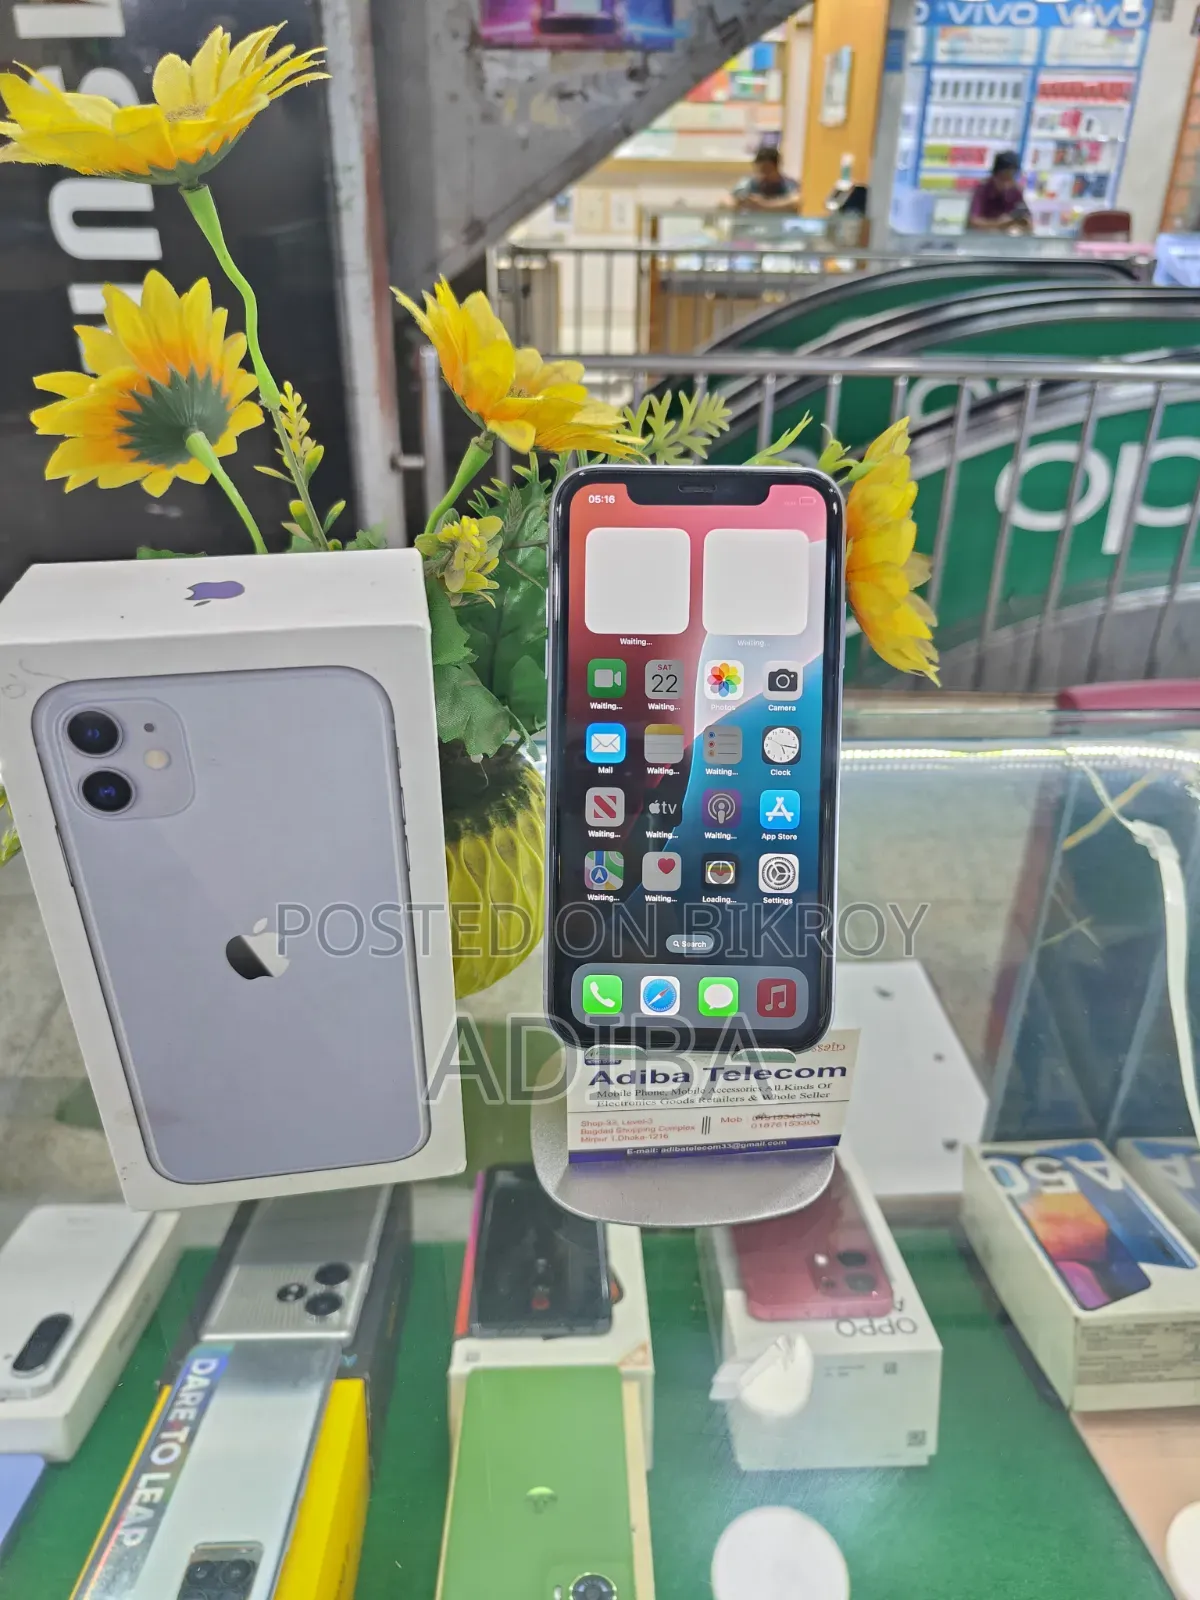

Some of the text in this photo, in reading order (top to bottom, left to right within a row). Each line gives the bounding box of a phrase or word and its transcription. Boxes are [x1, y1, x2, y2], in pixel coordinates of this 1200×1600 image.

[947, 2, 1039, 26] vivo
[588, 495, 615, 504] 05:16
[620, 638, 652, 647] Waiting...
[651, 674, 678, 693] 22
[590, 702, 623, 711] Waiting...
[648, 703, 681, 711] Waiting...
[710, 703, 736, 711] Photos
[768, 704, 796, 712] Camera
[647, 767, 680, 776] Waiting...
[705, 768, 738, 776] Waiting...
[588, 830, 621, 839] Waiting...
[646, 831, 678, 840] Waiting...
[704, 832, 737, 841] Waiting...
[761, 833, 797, 842] App Store
[587, 894, 620, 902] Waiting...
[645, 895, 677, 903] Waiting...
[702, 896, 737, 904] Loading...
[763, 897, 793, 905] Settings
[681, 940, 707, 948] Search
[588, 1065, 847, 1086] Adiba Telecom
[597, 1089, 631, 1098] Mobile
[671, 1086, 705, 1096] Mobile
[708, 1085, 761, 1094] Accessories
[818, 1082, 832, 1090] Of
[597, 1099, 656, 1107] Electronics
[698, 1096, 744, 1104] Retailers
[762, 1093, 796, 1101] Whole
[616, 1126, 655, 1134] Shopping
[626, 1147, 658, 1155] E-mail:
[836, 1316, 917, 1337] OPPO
[119, 1358, 219, 1547] DARE TO LEAP
